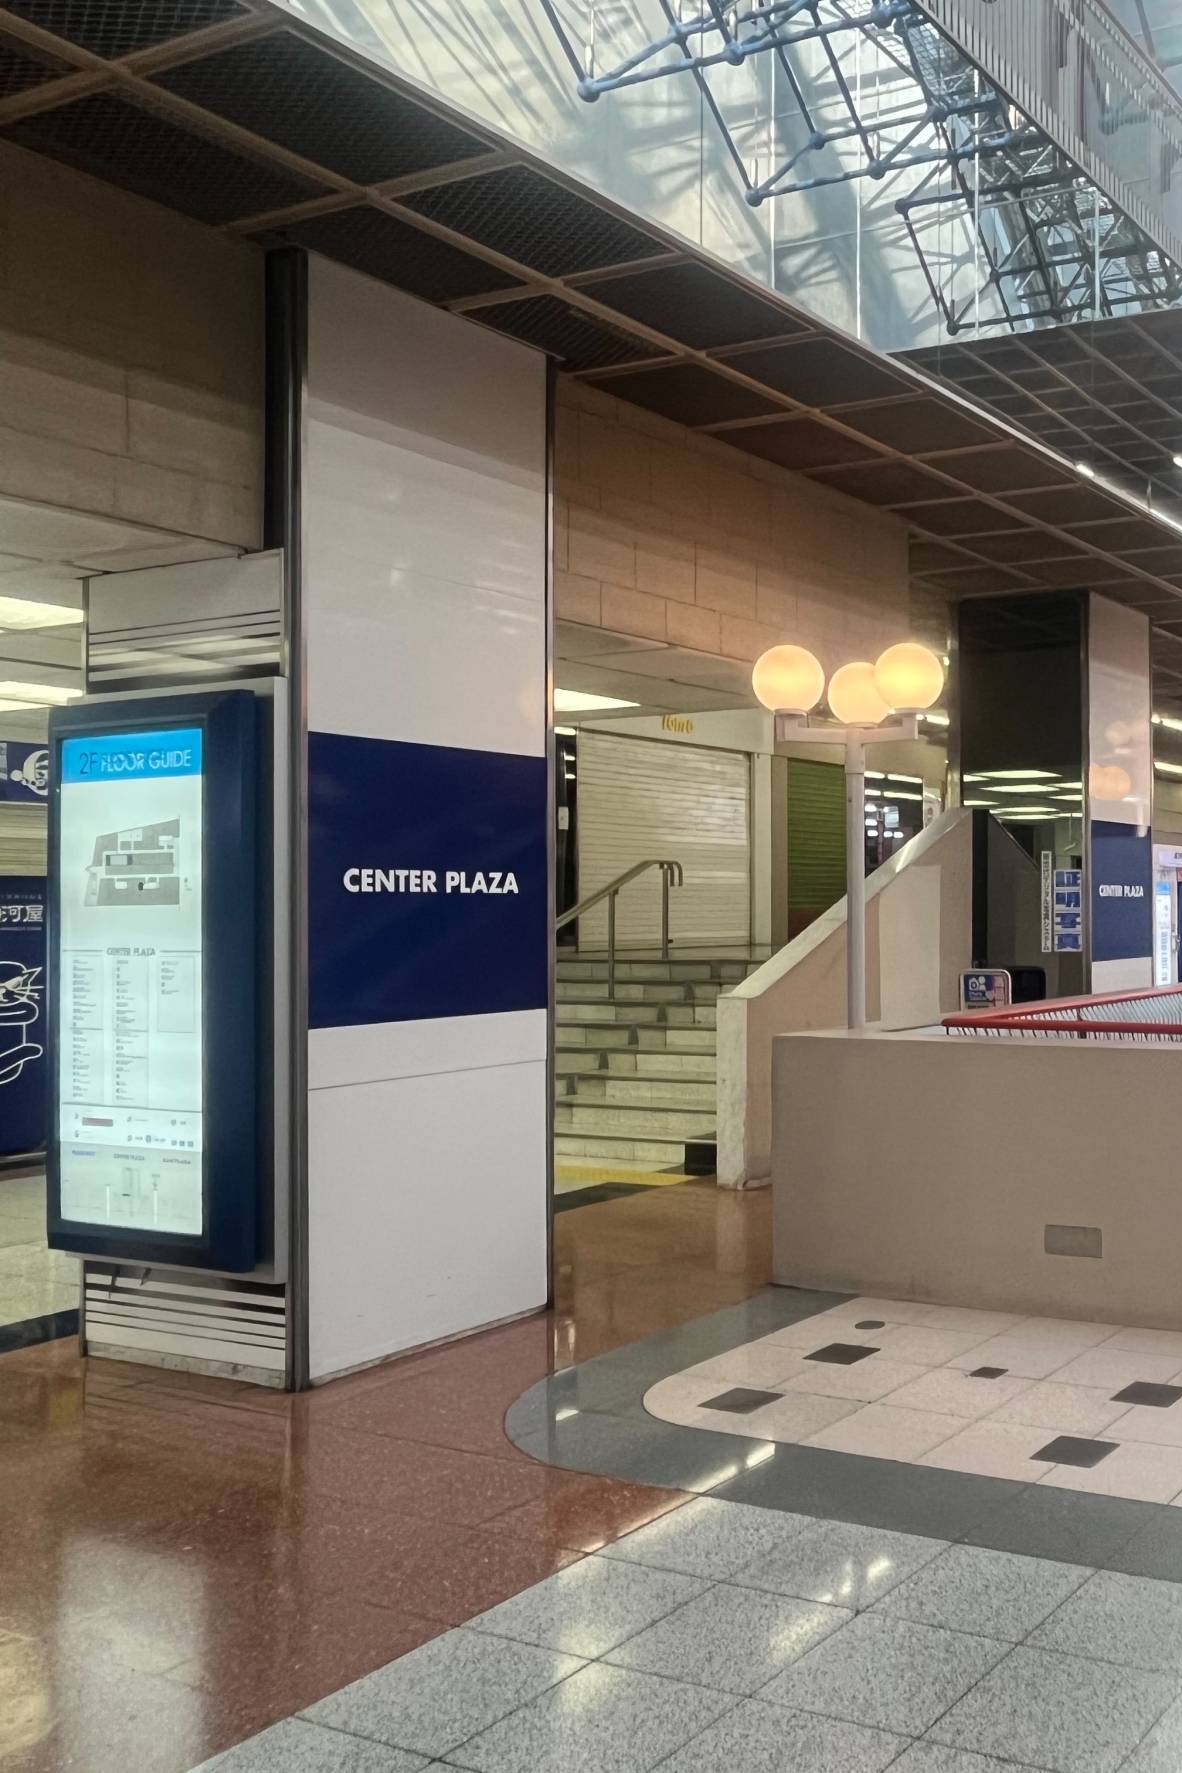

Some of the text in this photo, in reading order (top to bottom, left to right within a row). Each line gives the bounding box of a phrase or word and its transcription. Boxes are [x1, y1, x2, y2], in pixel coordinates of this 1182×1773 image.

[80, 749, 192, 775] 2F FLOOR GUIDE
[343, 867, 519, 894] CENTER PLAZA
[1099, 884, 1144, 897] CENTER PLAZA
